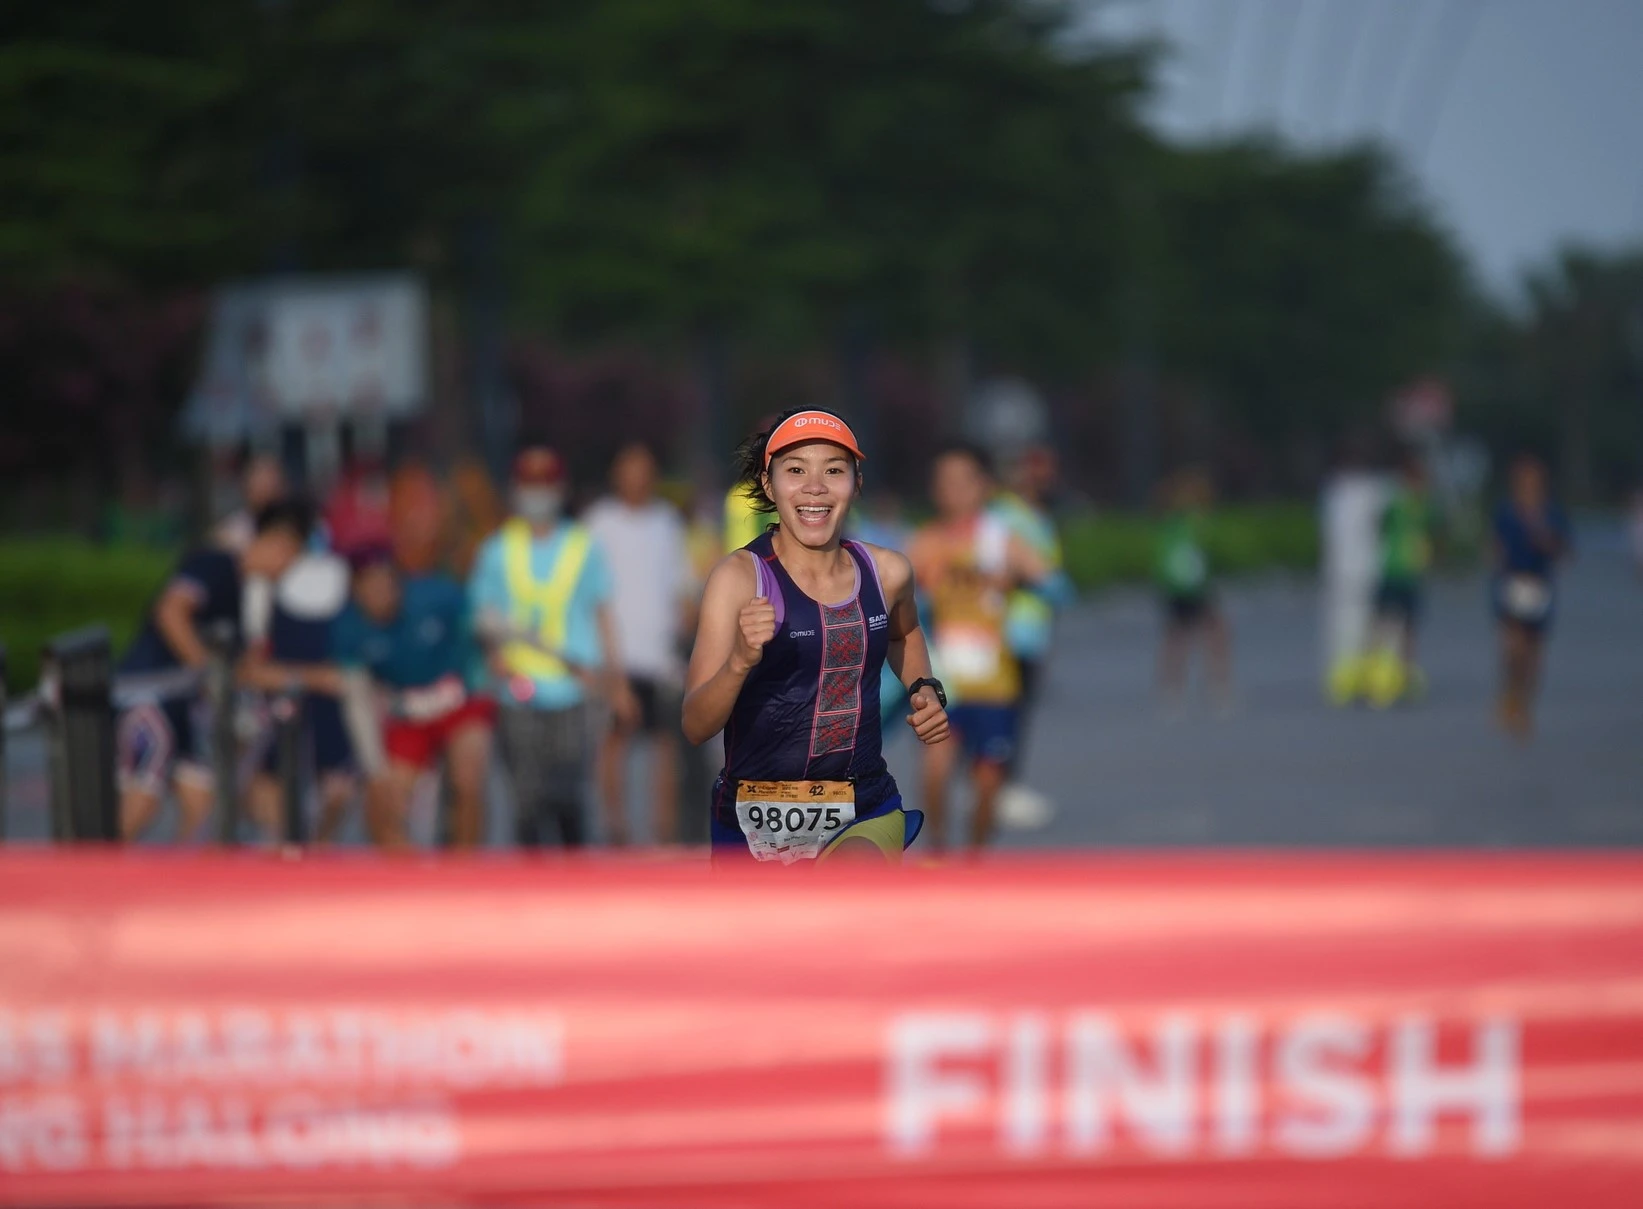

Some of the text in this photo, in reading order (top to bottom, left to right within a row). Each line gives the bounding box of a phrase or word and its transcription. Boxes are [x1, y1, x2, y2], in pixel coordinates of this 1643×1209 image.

[748, 806, 841, 833] 98075
[809, 785, 824, 796] 42
[93, 1008, 563, 1087] MARATHON
[888, 1011, 1523, 1159] FINISH
[105, 1094, 458, 1171] HALONG
